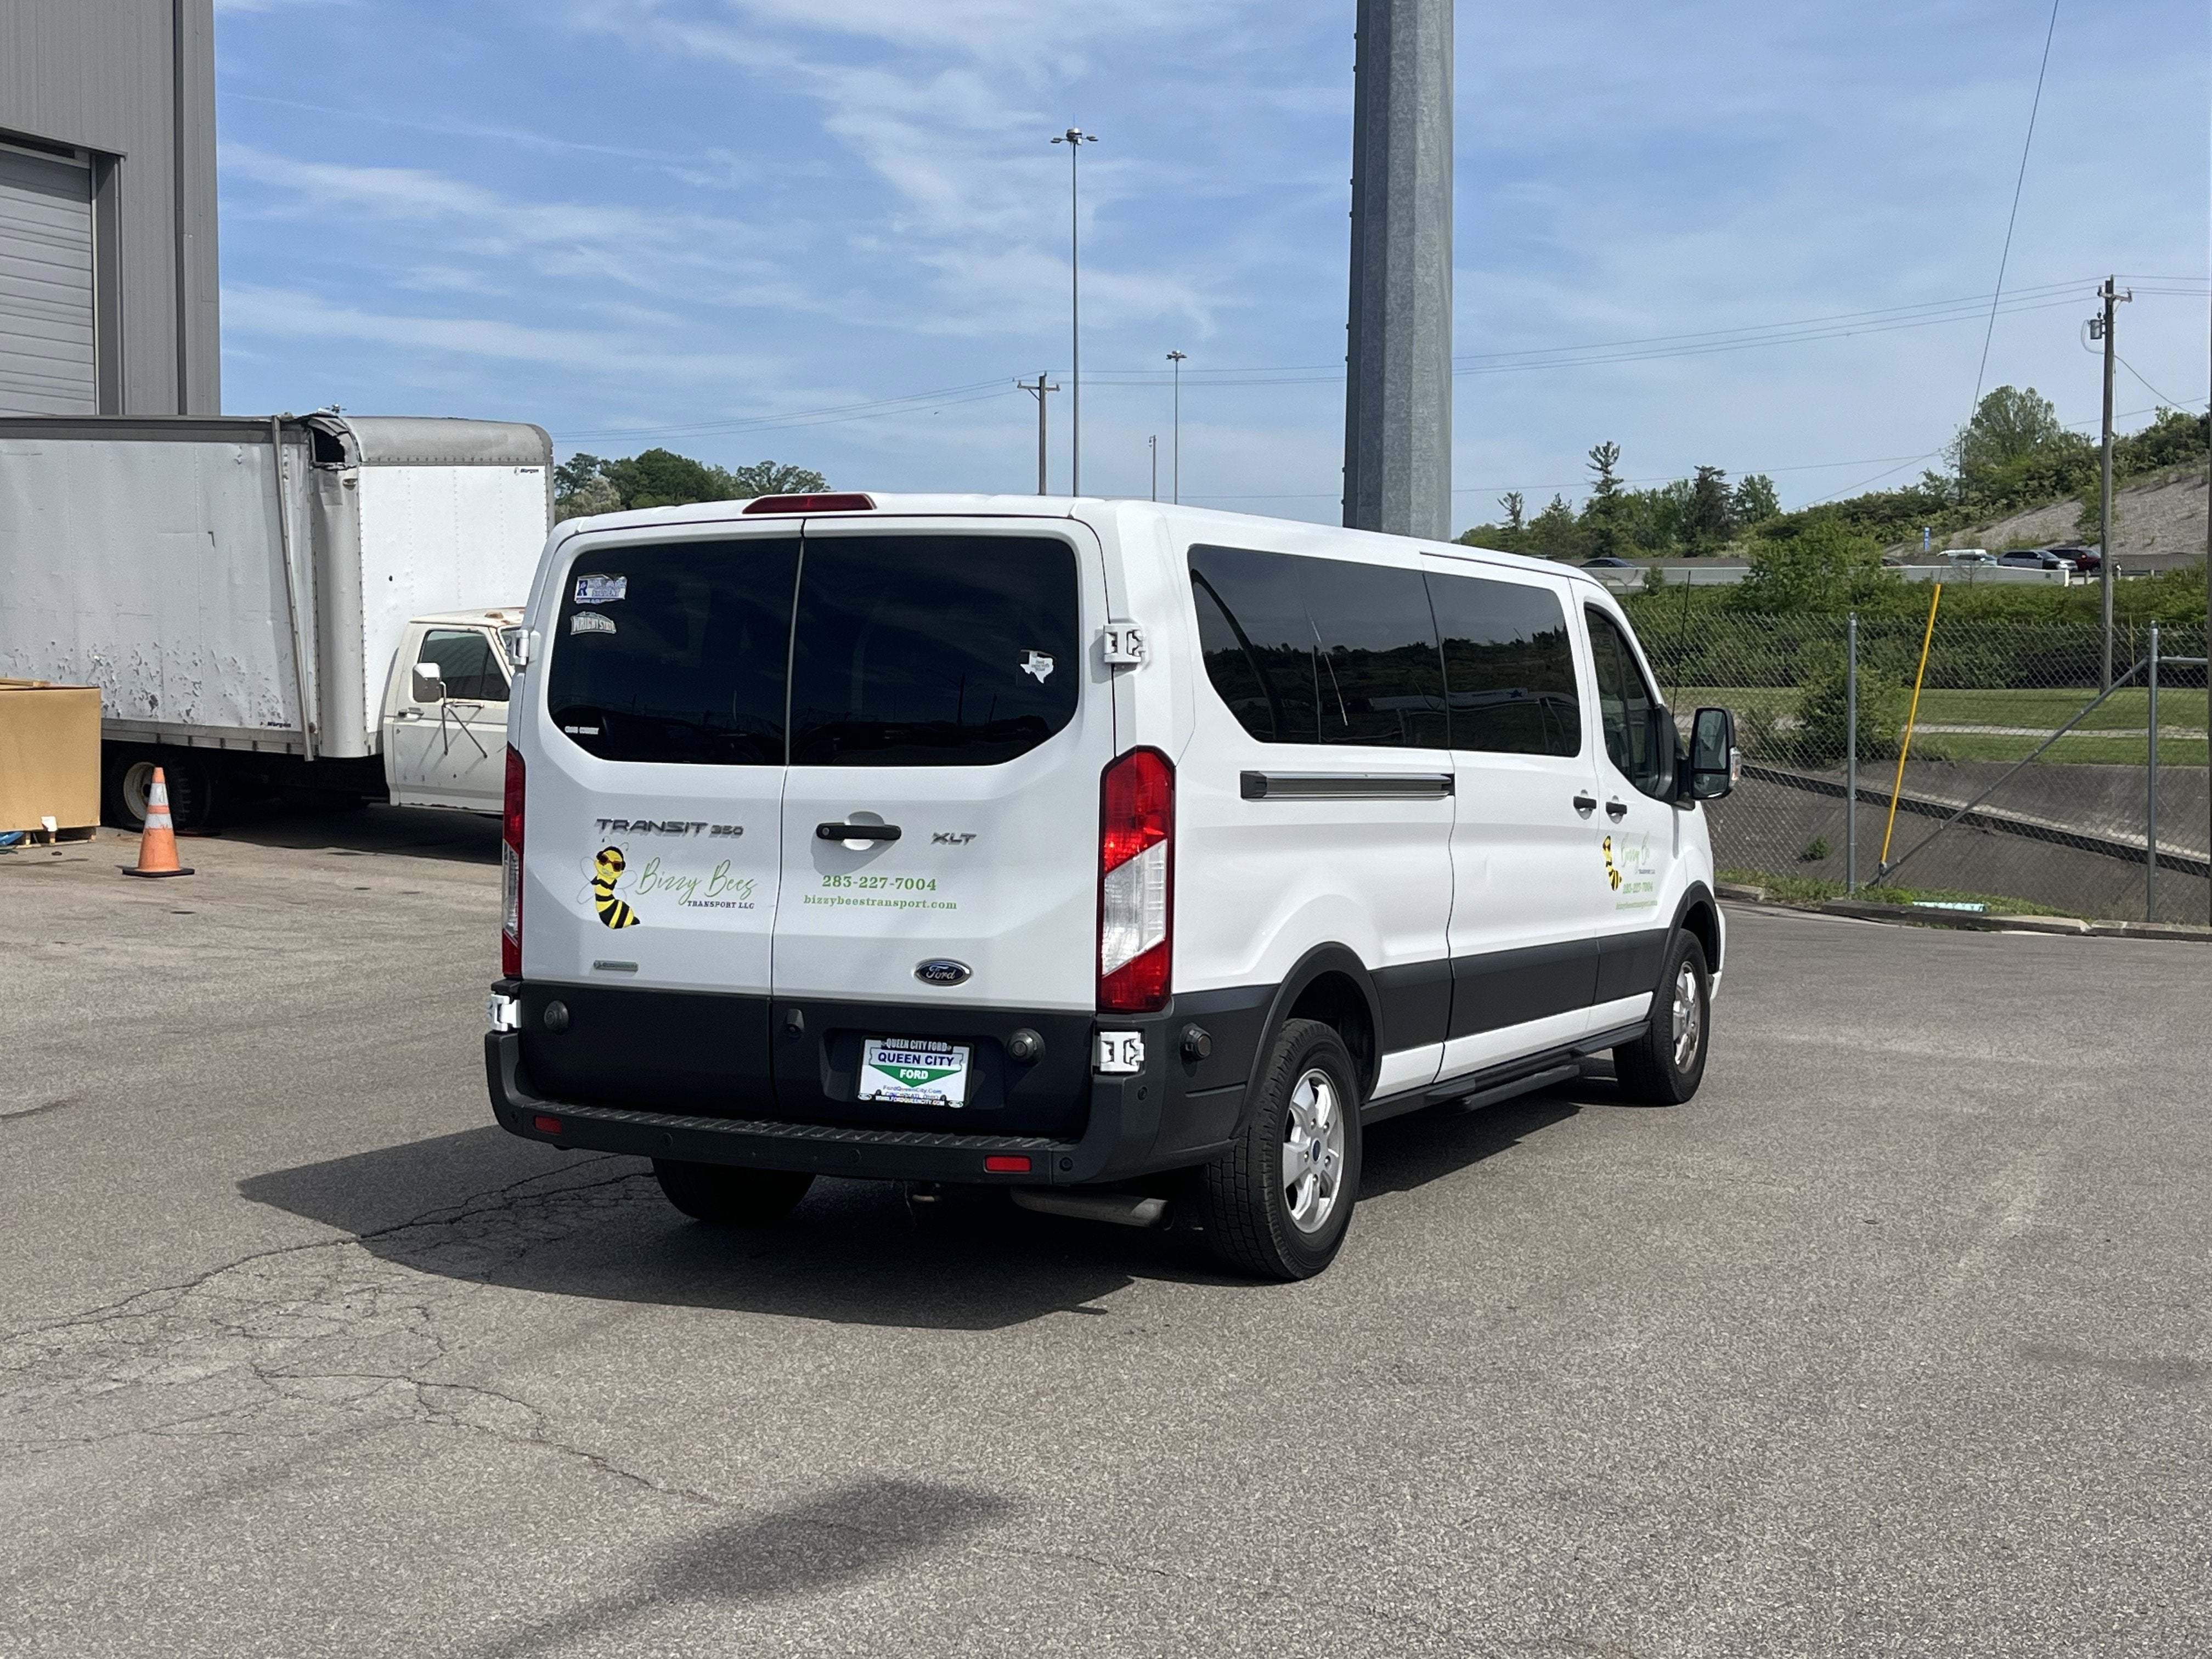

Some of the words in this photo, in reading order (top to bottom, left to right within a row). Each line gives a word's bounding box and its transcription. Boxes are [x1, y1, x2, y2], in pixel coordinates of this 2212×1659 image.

[596, 819, 708, 833] TRANSIT
[710, 825, 743, 836] 350
[931, 832, 977, 845] XLT
[635, 857, 702, 905] Bizzy
[704, 859, 758, 900] Bees
[822, 876, 936, 891] 283-227-7004
[803, 895, 957, 910] bizzybeestransport.com
[926, 964, 956, 980] Ford
[886, 1038, 909, 1049] QUEEN
[910, 1040, 927, 1051] CITY
[928, 1041, 947, 1052] FORD
[878, 1052, 921, 1065] QUEEN
[925, 1056, 955, 1066] CITY
[900, 1069, 929, 1079] FORD
